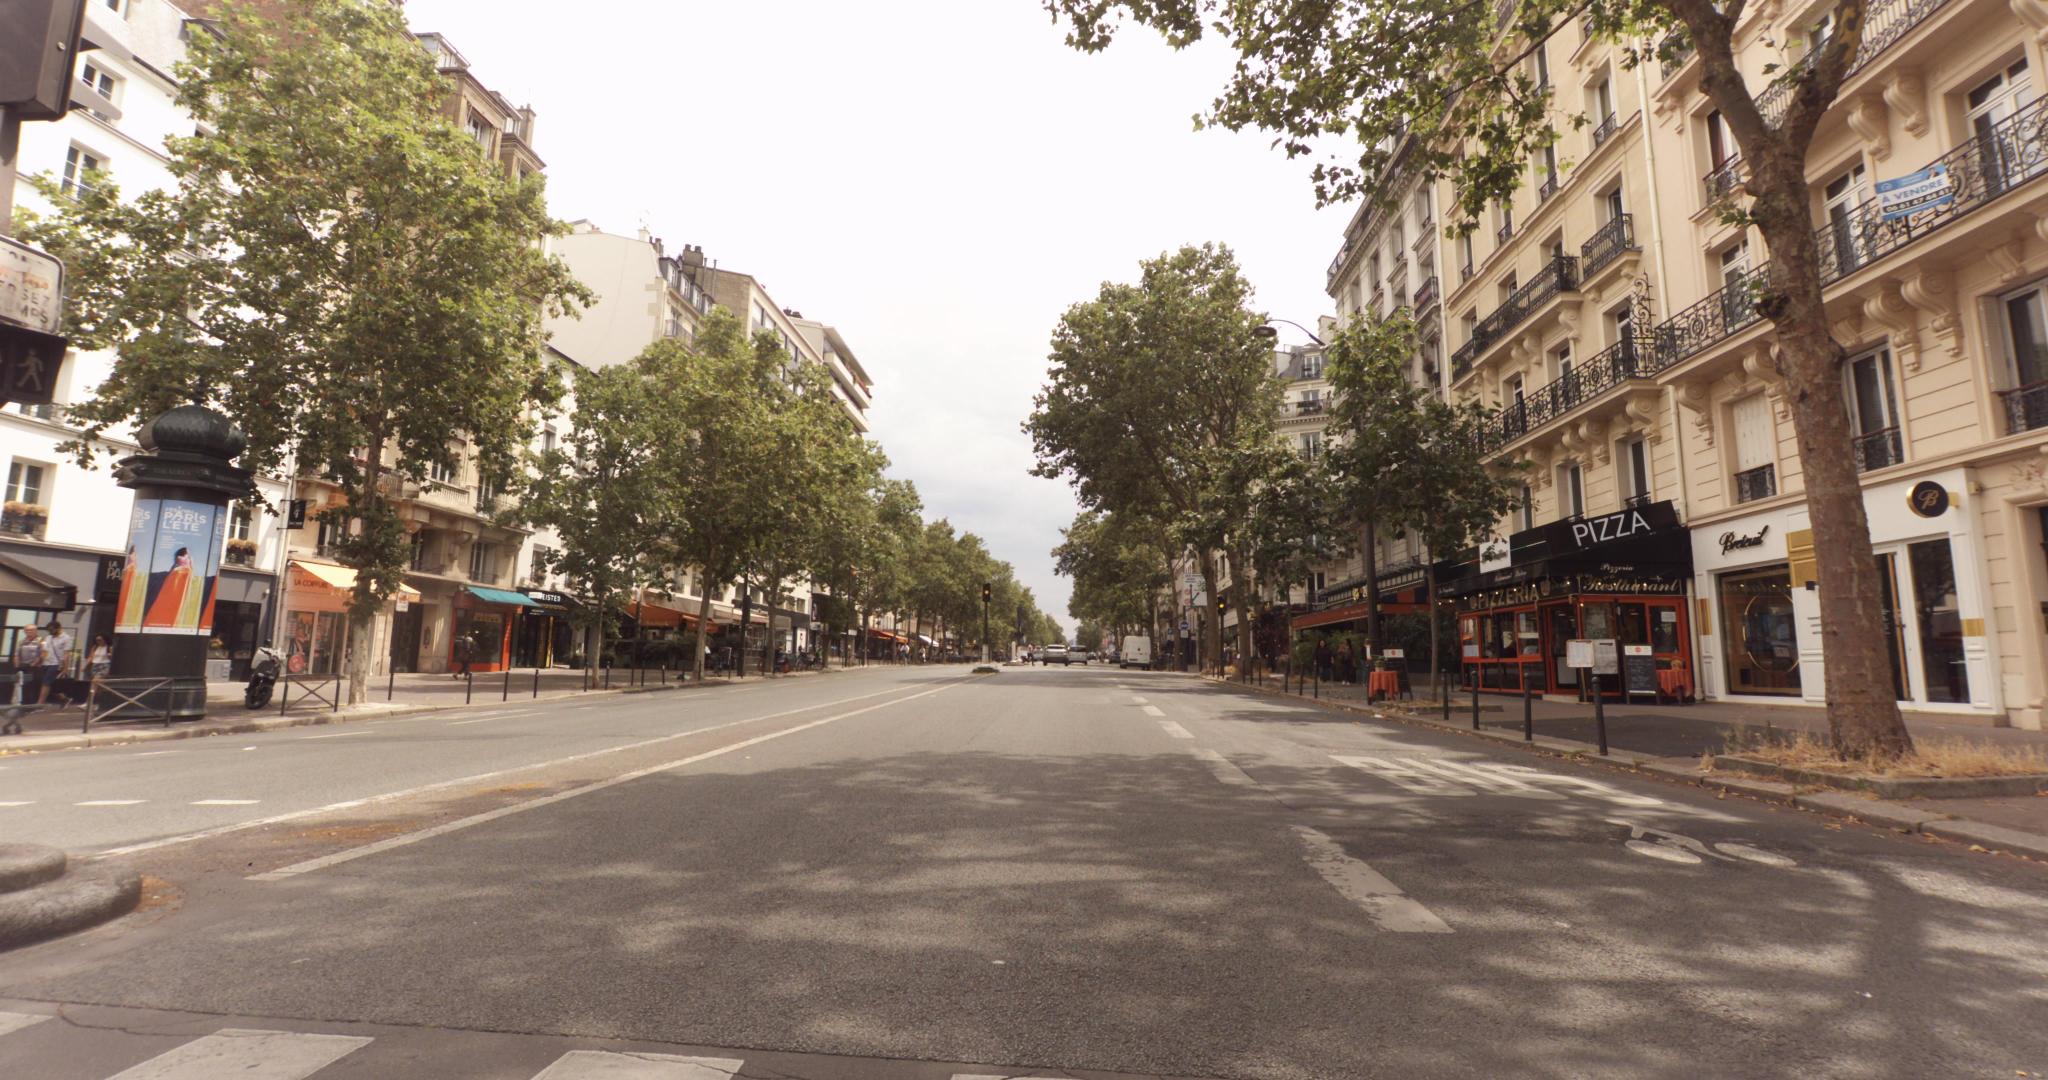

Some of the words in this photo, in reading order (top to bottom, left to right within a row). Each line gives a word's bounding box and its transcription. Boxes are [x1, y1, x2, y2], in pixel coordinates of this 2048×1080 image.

[1894, 180, 1943, 199] VENDRE
[1572, 511, 1651, 547] PIZZA
[1719, 525, 1769, 556] Breteuil
[1600, 563, 1634, 574] Pizzeria
[1478, 586, 1540, 608] PIZZERIA
